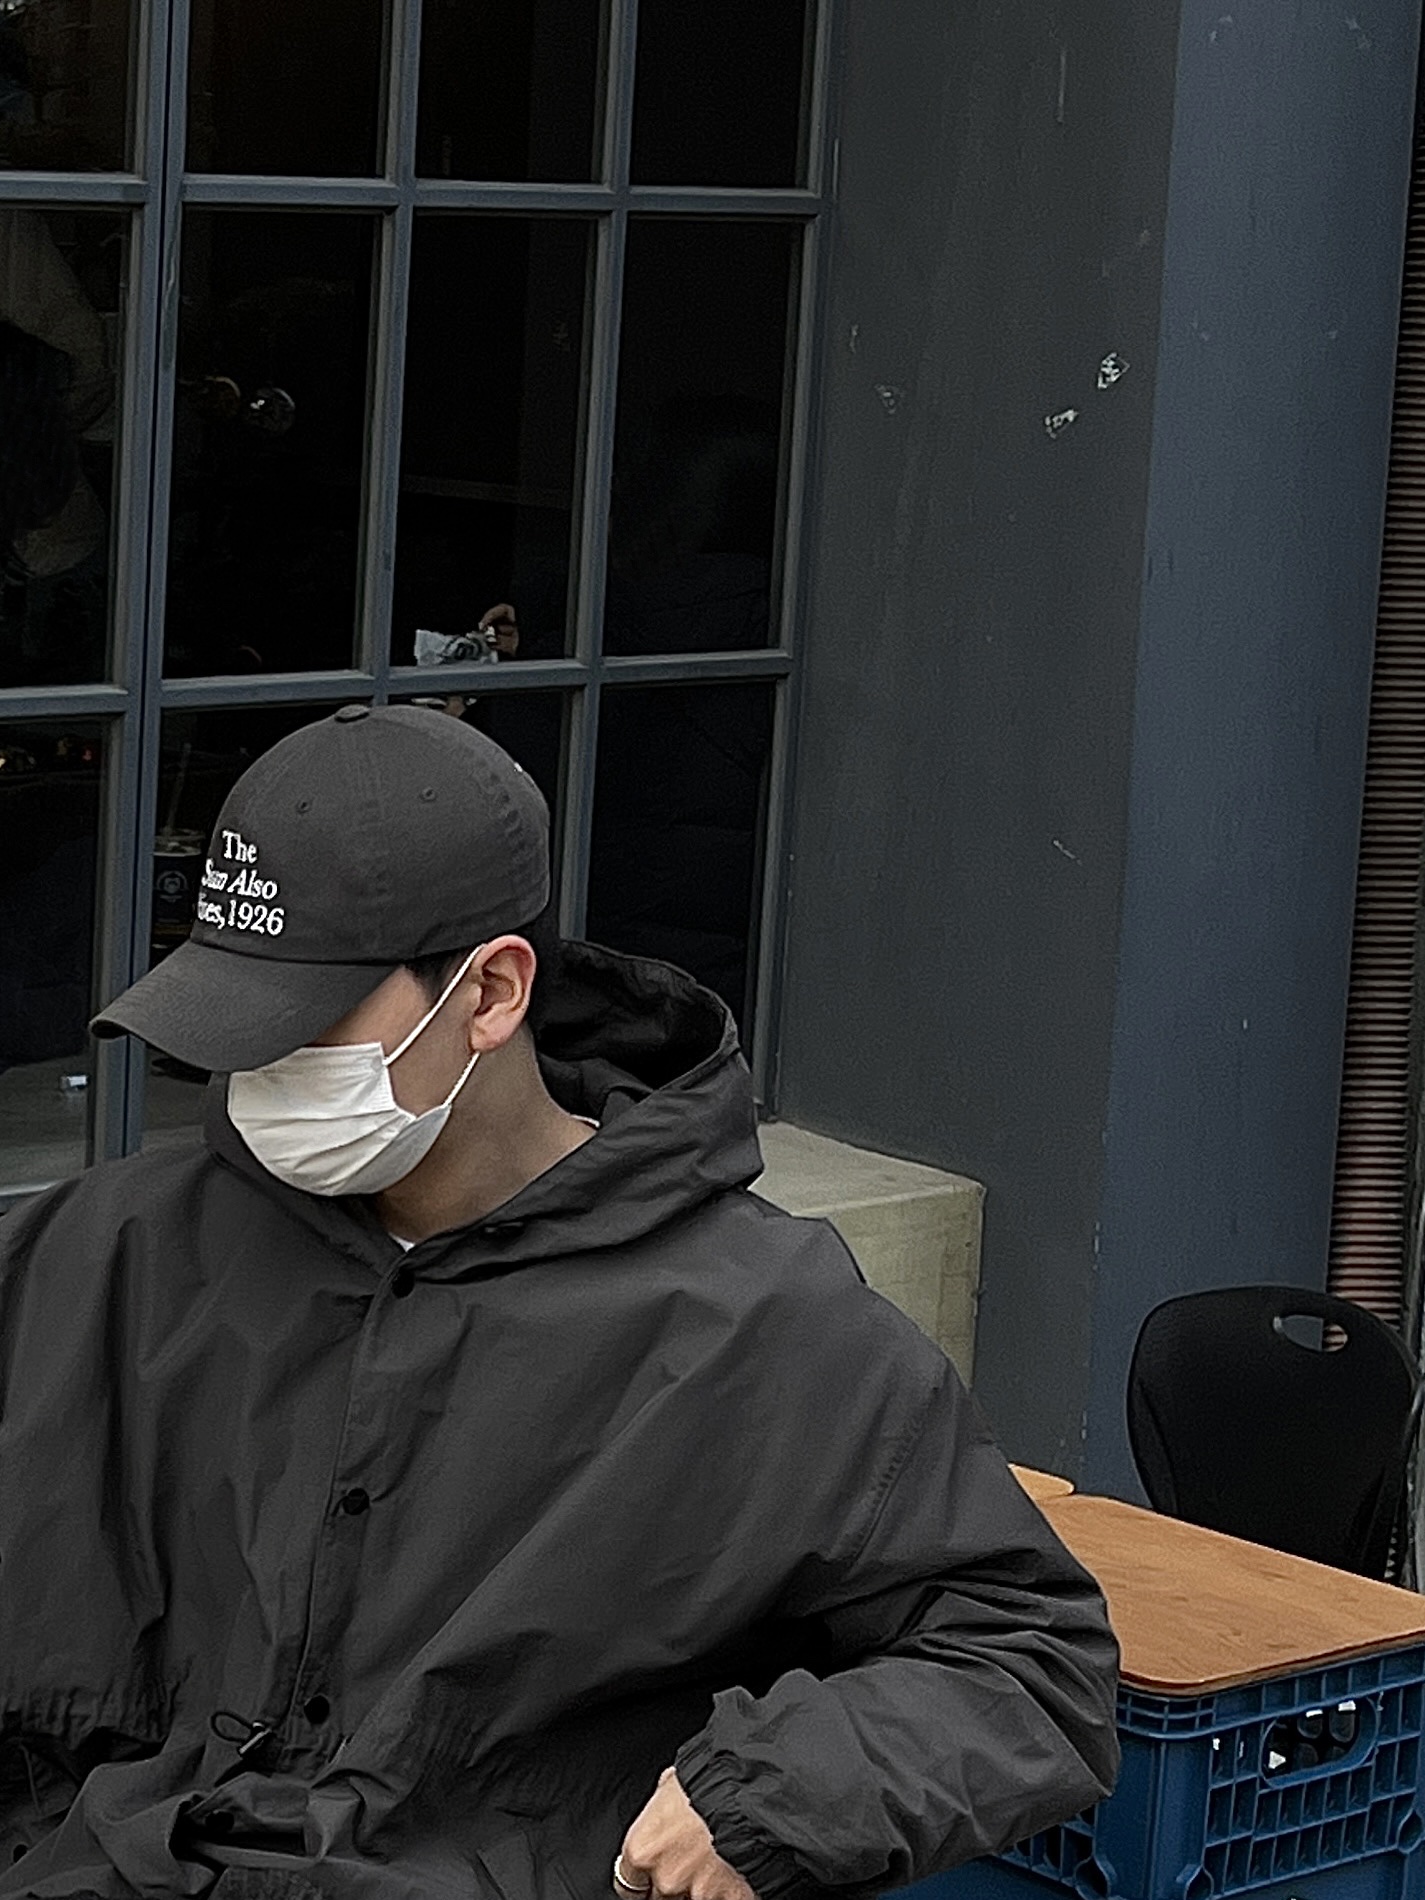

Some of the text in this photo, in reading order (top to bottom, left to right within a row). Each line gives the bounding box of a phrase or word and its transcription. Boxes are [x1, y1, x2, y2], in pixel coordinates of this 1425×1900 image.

[221, 829, 258, 864] The
[227, 868, 278, 900] Also
[227, 899, 285, 936] 1926
